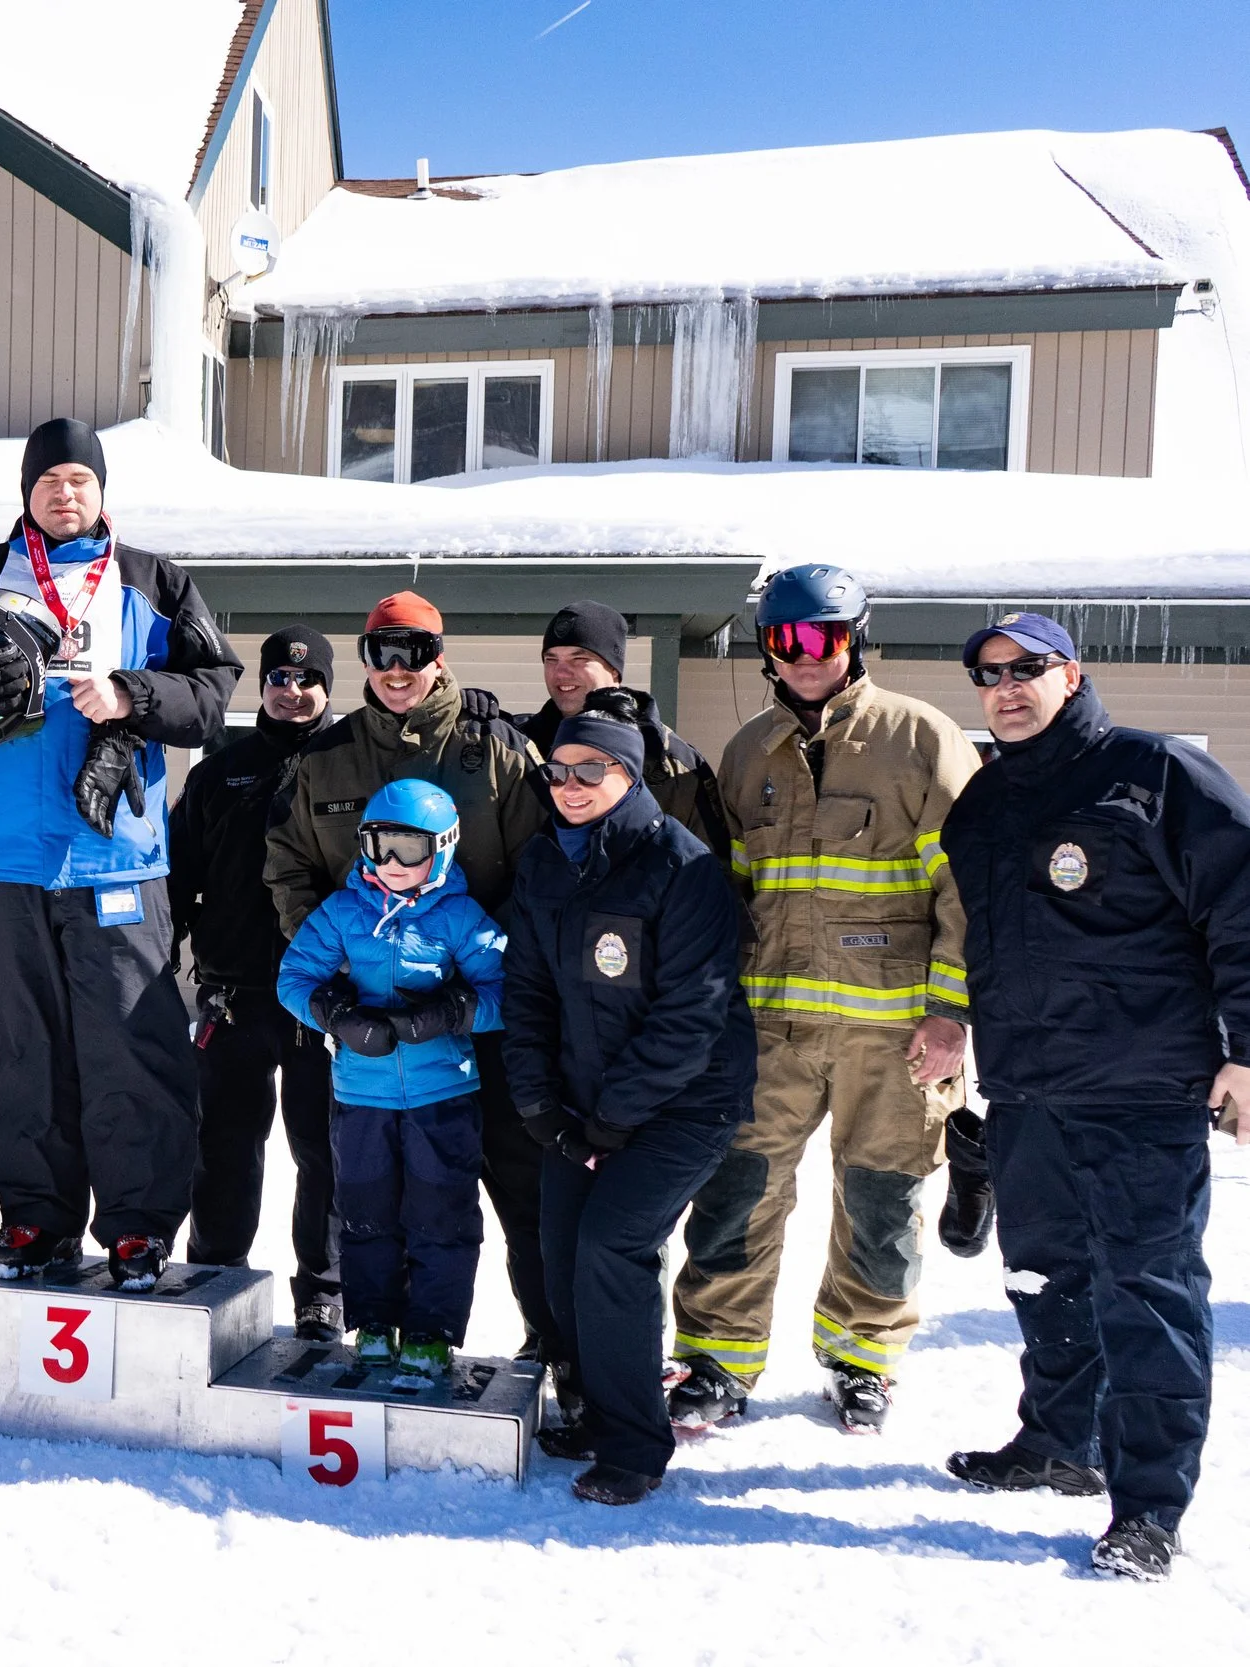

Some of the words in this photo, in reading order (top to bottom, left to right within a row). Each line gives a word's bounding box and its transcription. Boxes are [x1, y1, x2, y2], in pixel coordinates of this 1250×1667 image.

[327, 801, 355, 813] SMARZ
[42, 1306, 91, 1384] 3
[307, 1409, 360, 1487] 5
